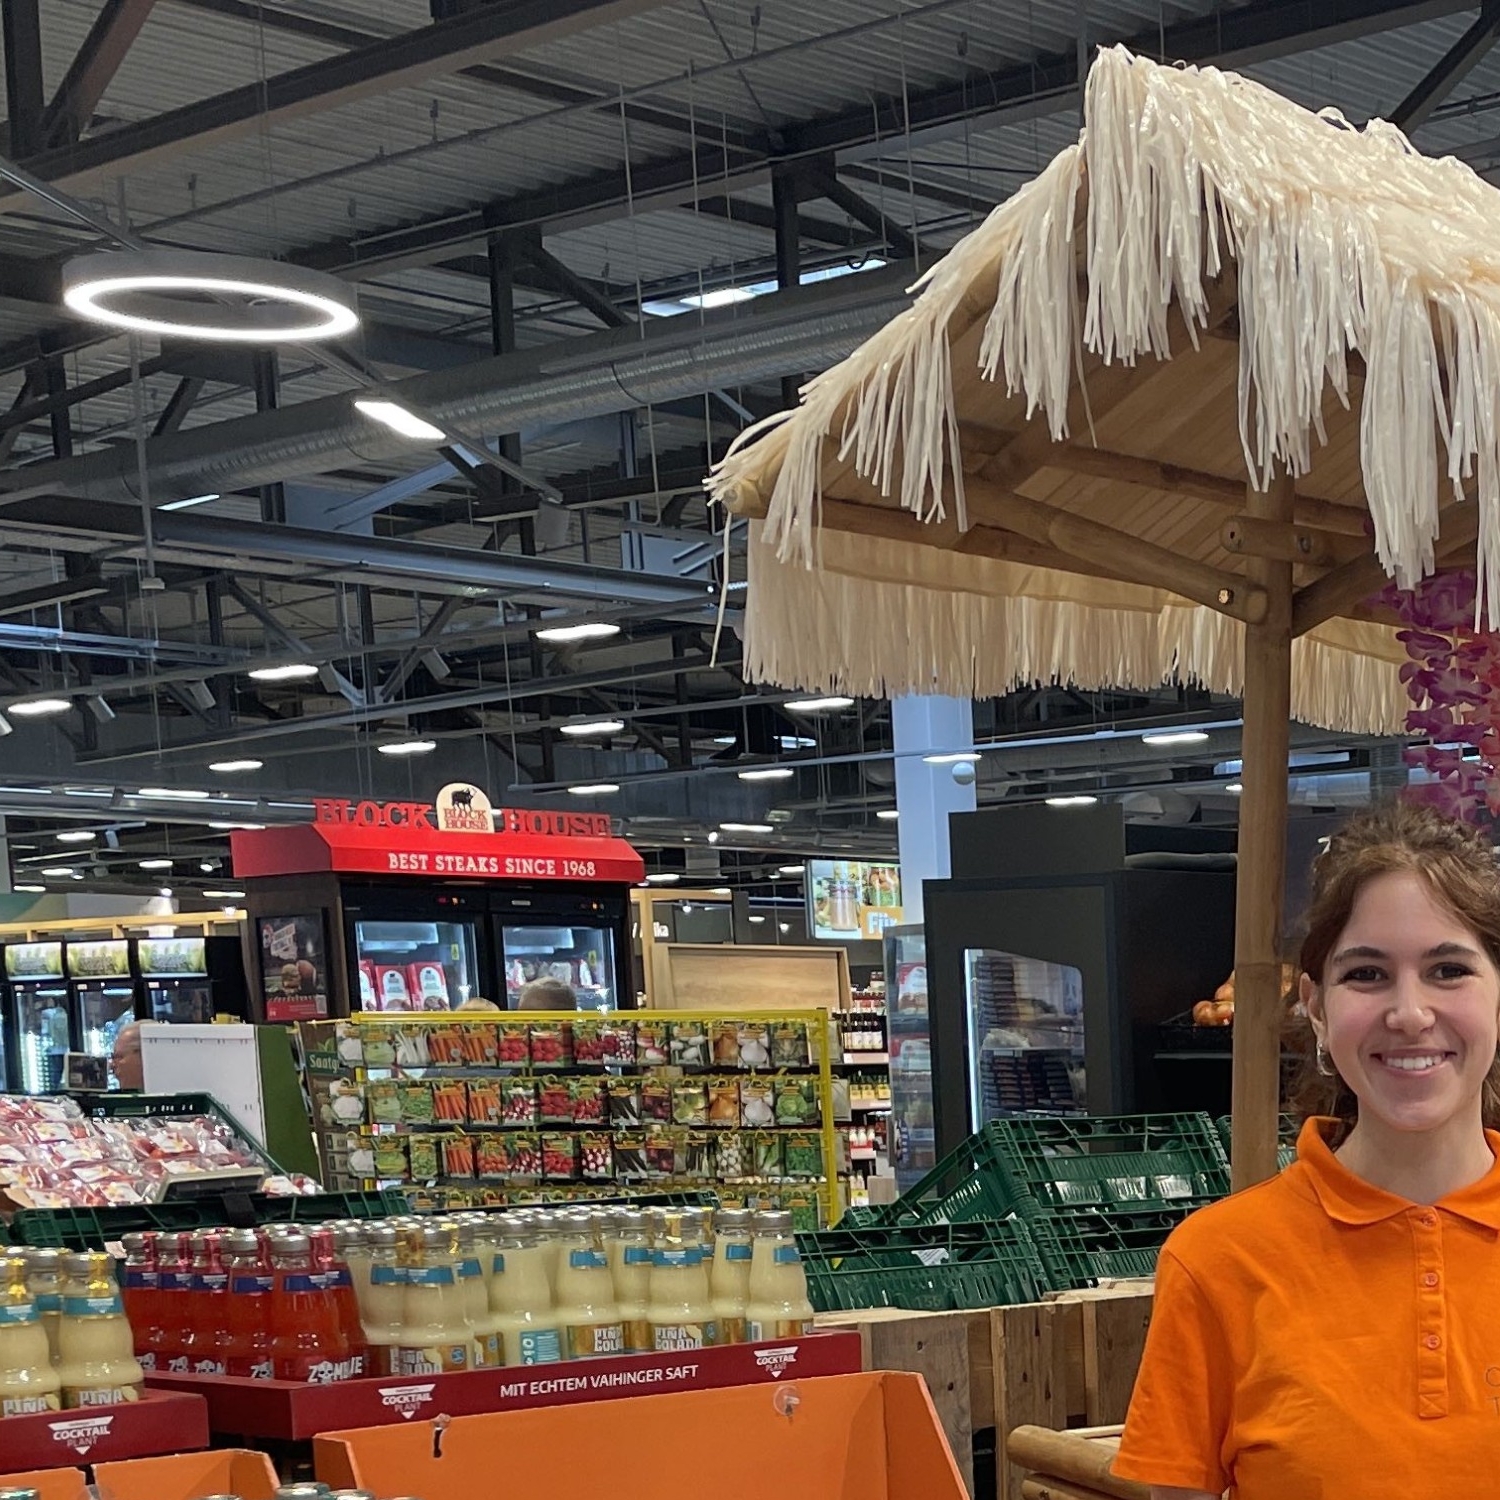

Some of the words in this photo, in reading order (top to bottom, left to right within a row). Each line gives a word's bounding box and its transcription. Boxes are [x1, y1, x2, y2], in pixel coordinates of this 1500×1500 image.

[313, 799, 434, 829] BLOCK
[502, 808, 612, 837] HOUSE
[443, 807, 488, 820] BLOCK
[445, 819, 489, 831] HOUSE
[388, 852, 429, 871] BEST
[435, 854, 498, 874] STEAKS
[505, 857, 556, 876] SINCE
[563, 860, 596, 877] 1968
[655, 1337, 703, 1350] COLADA
[756, 1354, 797, 1368] COCKTAIL
[500, 1383, 527, 1398] MIT
[529, 1377, 587, 1395] ECHTEM
[590, 1369, 663, 1389] VAIHINGER
[666, 1365, 698, 1381] SAFT
[382, 1392, 433, 1406] COCKTAIL
[53, 1425, 111, 1441] COCKTAIL
